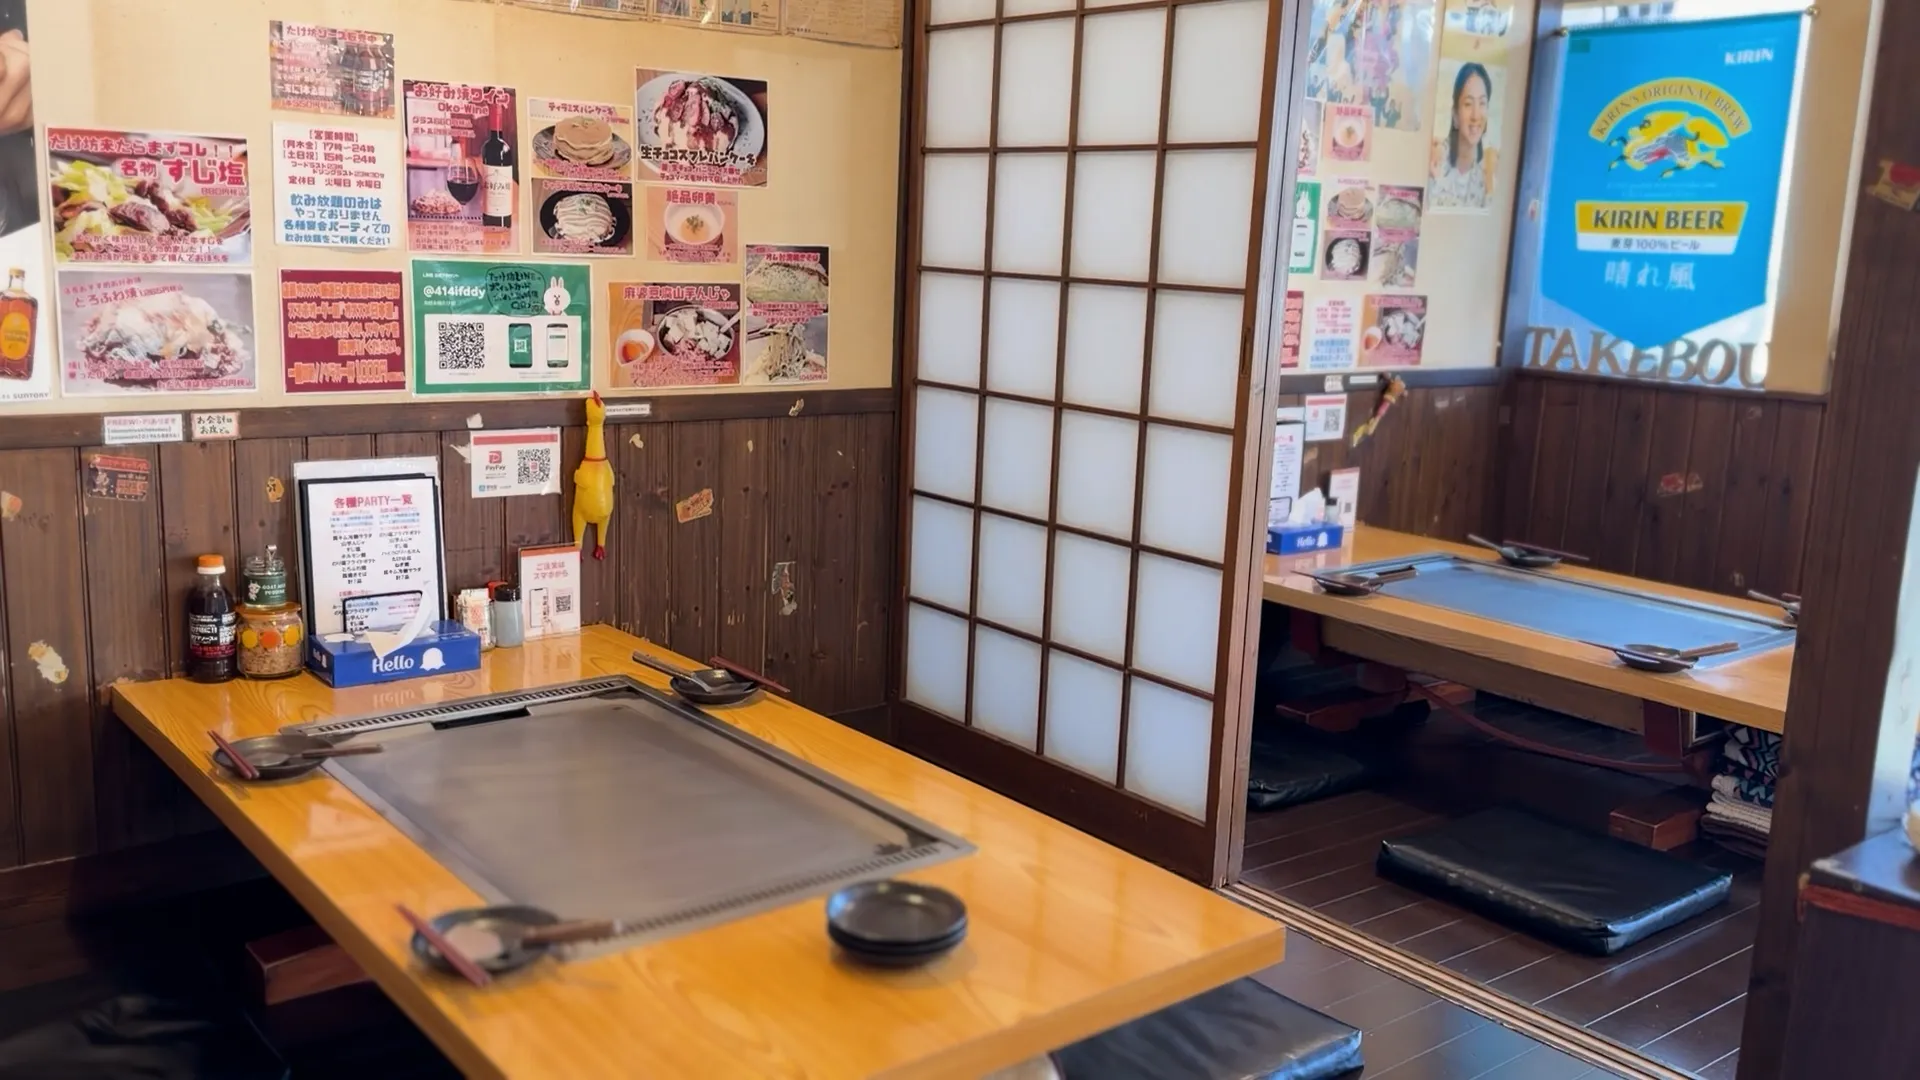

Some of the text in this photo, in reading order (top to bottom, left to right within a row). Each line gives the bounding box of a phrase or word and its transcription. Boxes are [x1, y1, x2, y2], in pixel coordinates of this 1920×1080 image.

[1724, 48, 1773, 65] KIRIN
[413, 83, 511, 104] お好み焼ワイン
[437, 102, 489, 115] Oko-Wine
[1642, 84, 1713, 103] ORIGINAL
[1714, 95, 1745, 132] BREW
[640, 145, 756, 166] 生チョコスフレパンケーキ
[121, 158, 246, 187] 名物 すじ塩
[288, 176, 382, 189] 定休日 火曜日 水曜日
[290, 194, 382, 210] 飲み放題のみは
[666, 190, 715, 204] 絶品卵黄
[295, 207, 381, 222] やっておりません
[1593, 209, 1725, 230] KIRIN BEER
[1610, 237, 1700, 250] 麦芽100%ビール
[1604, 260, 1696, 290] 晴れ風
[423, 285, 486, 298] @414ifddy
[334, 494, 413, 508] 各種PARTY一覧
[536, 562, 566, 571] ご注文は
[533, 570, 568, 580] スマホから
[372, 655, 414, 673] Hello
